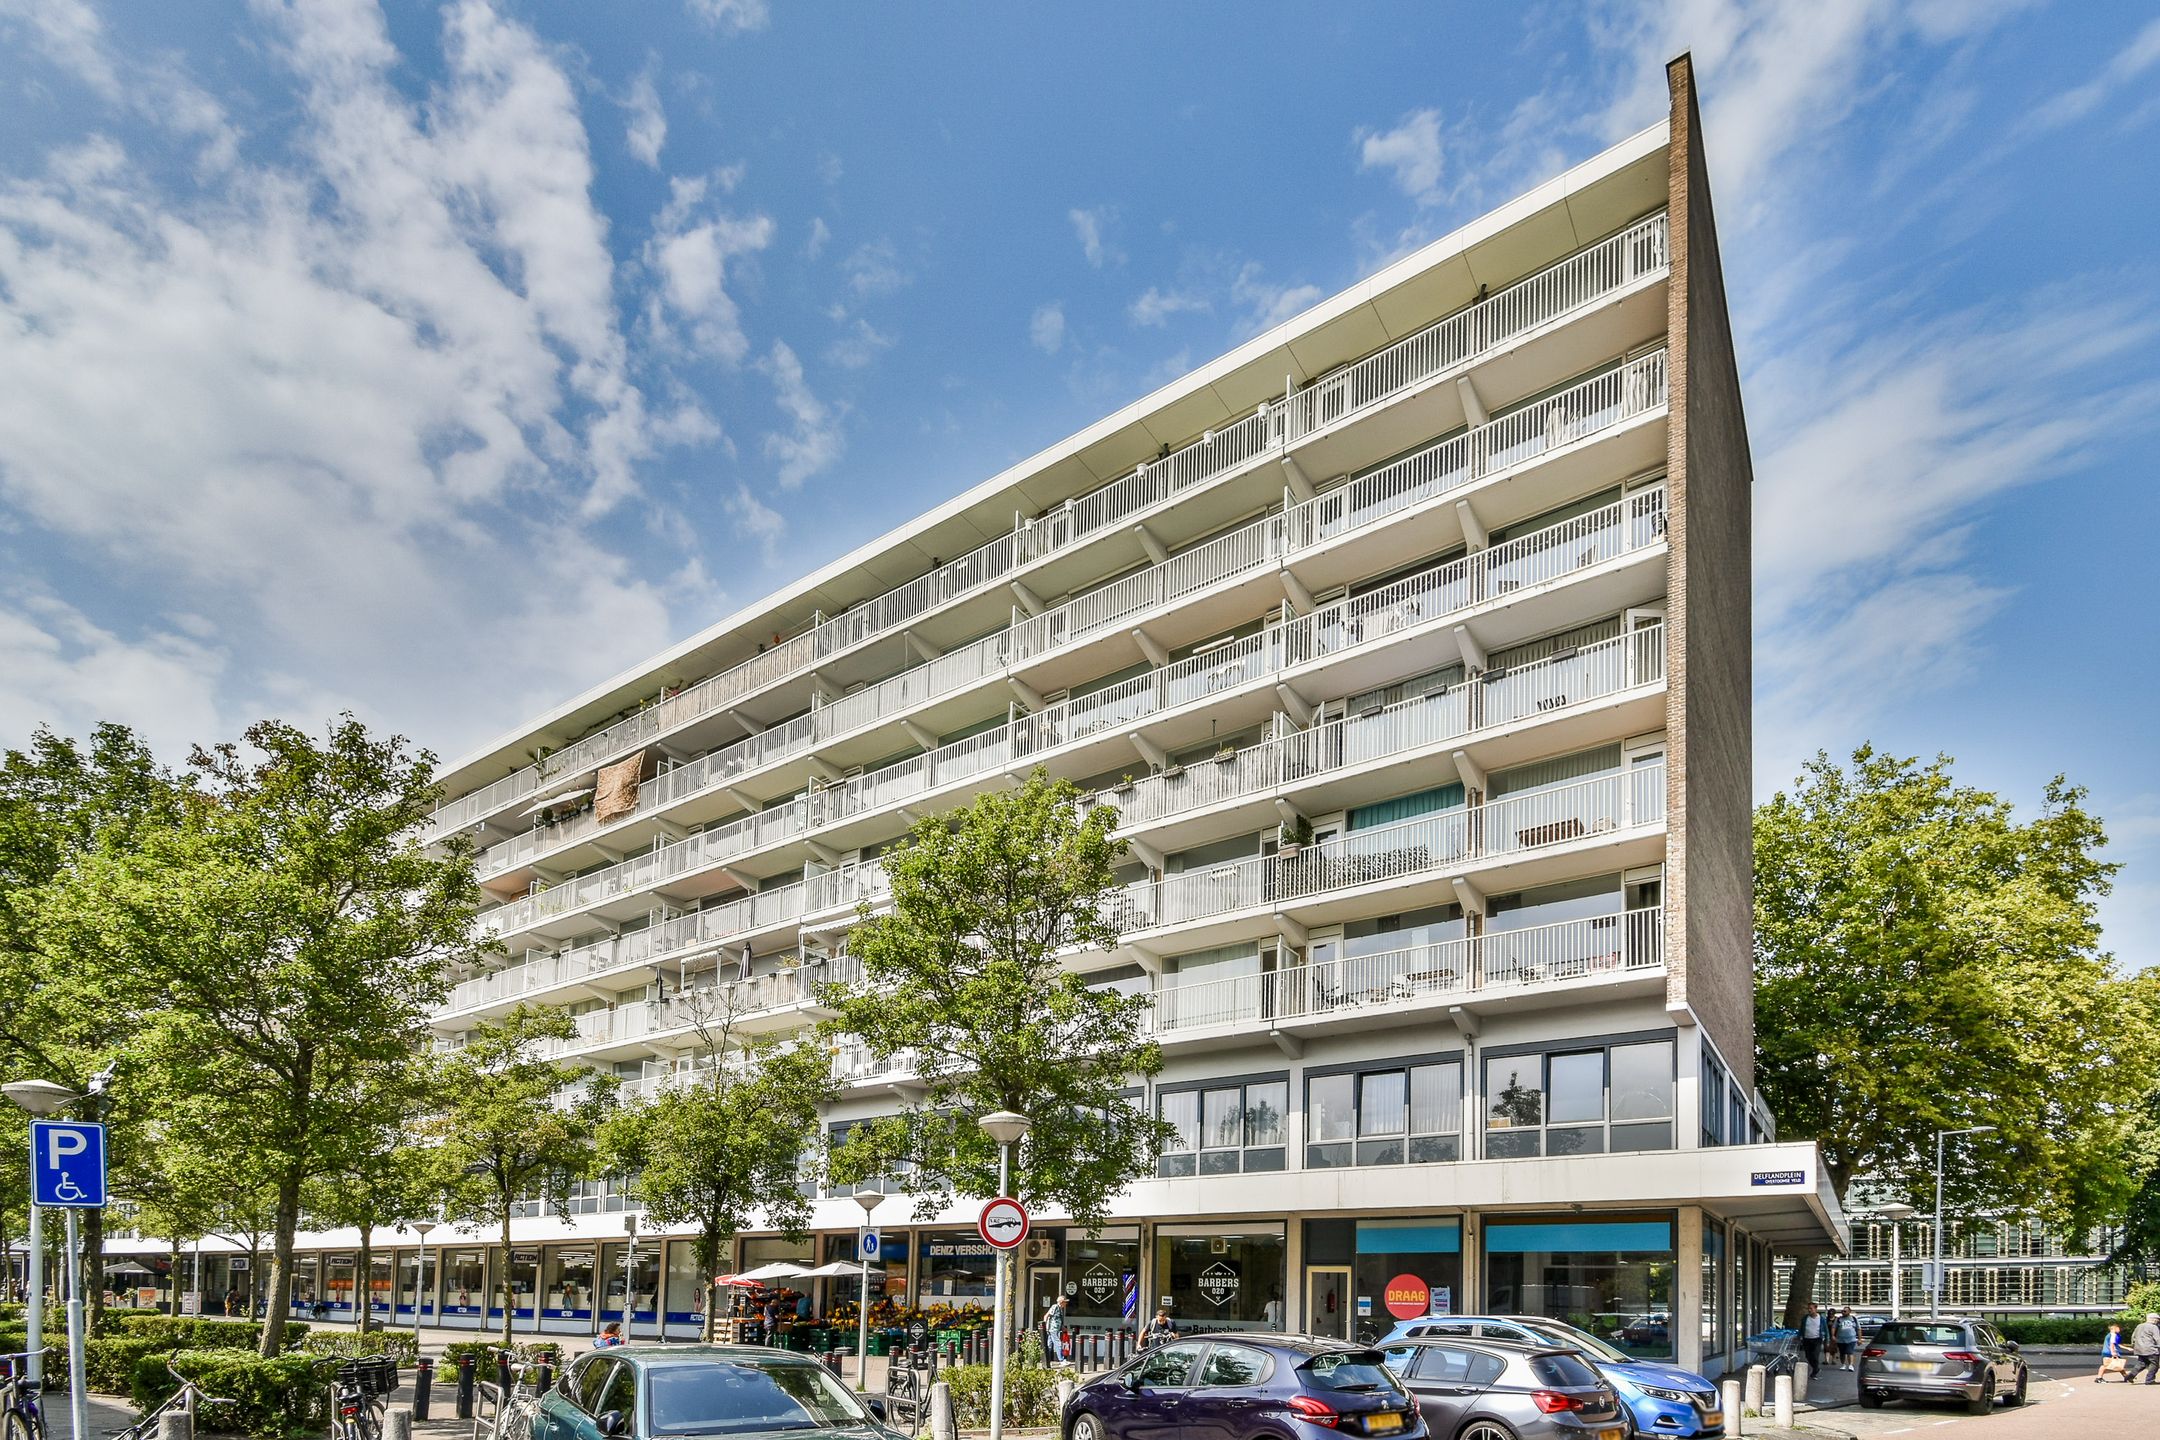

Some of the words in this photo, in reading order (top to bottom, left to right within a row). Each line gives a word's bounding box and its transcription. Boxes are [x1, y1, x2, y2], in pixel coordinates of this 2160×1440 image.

[48, 1128, 88, 1170] P
[1754, 1171, 1802, 1180] DELFLANDPLEIN
[930, 1244, 953, 1256] DENIZ
[331, 1257, 353, 1265] ACTION
[515, 1252, 538, 1262] ACTION
[1082, 1278, 1118, 1287] BARBERS
[1198, 1278, 1239, 1288] BARBERS
[1388, 1290, 1426, 1302] DRAAG
